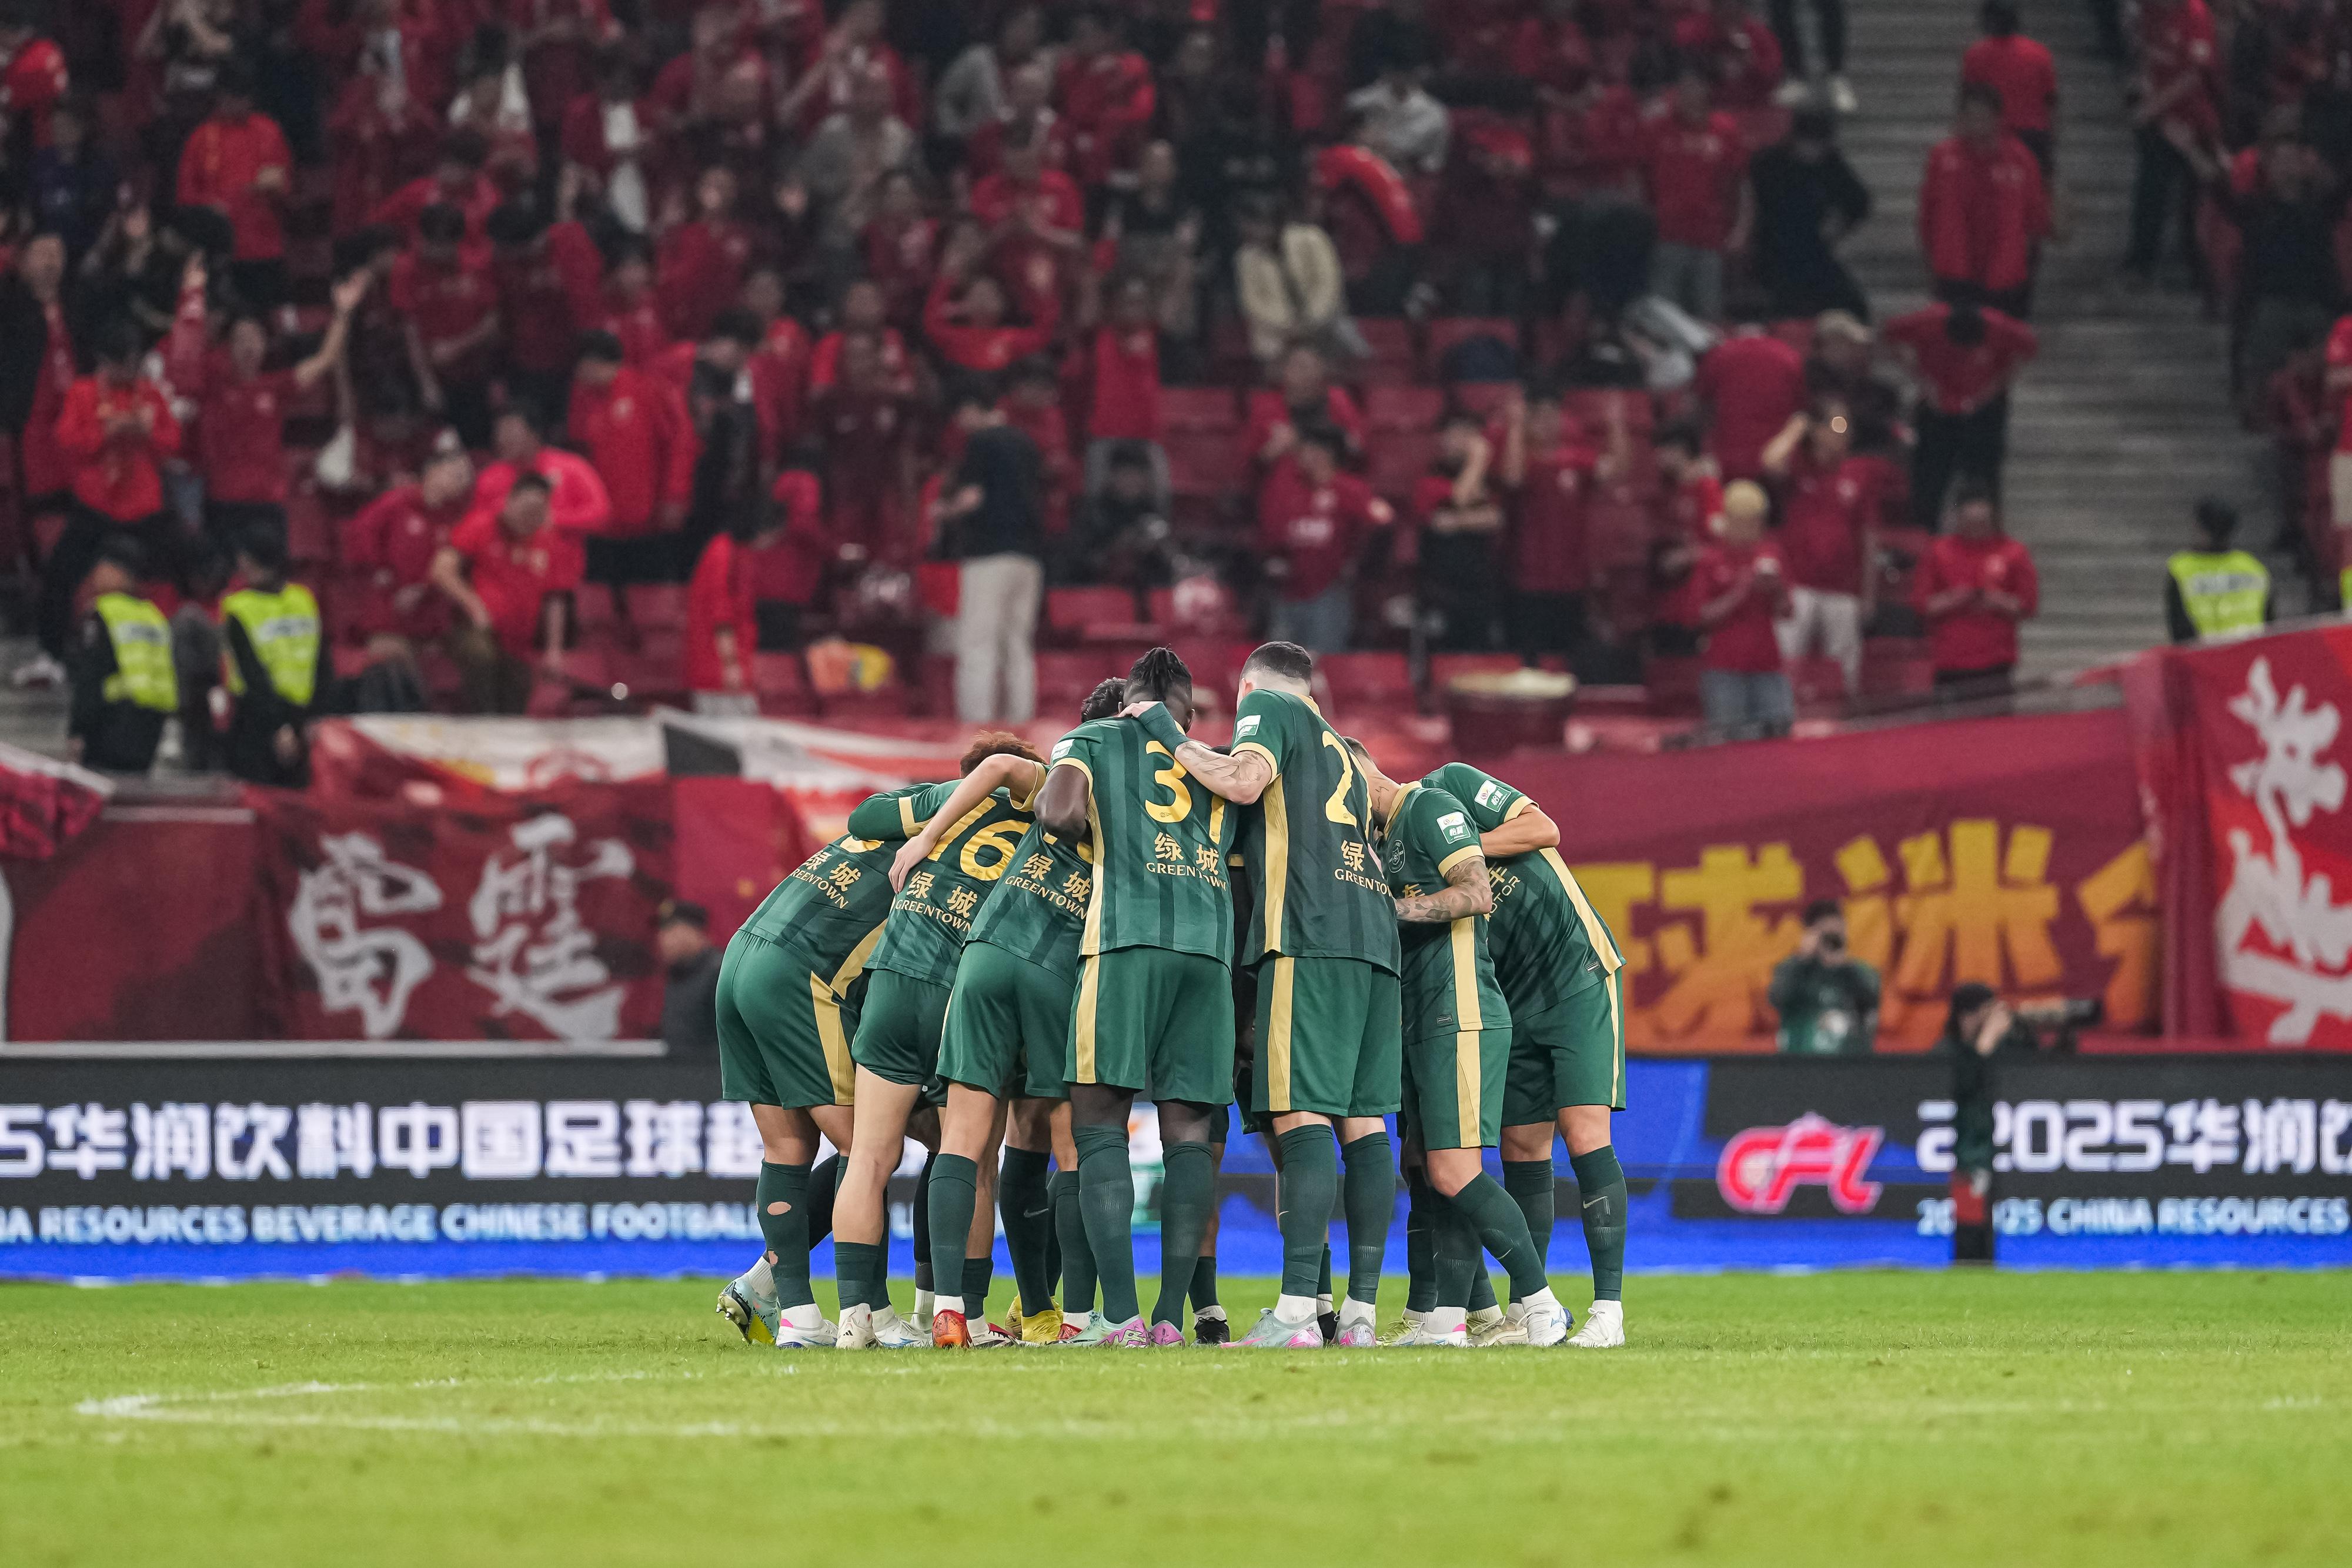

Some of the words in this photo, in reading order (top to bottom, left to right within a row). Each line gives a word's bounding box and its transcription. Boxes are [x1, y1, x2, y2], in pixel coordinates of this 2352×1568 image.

[927, 797, 1033, 881] 16
[906, 870, 978, 918] 绿城
[1005, 875, 1087, 920] GREENTOWN
[1020, 852, 1091, 902] 绿城
[895, 898, 971, 932] GREENTOWN
[39, 1205, 248, 1244] RESOURCES
[250, 1203, 437, 1242] BEVERAGE
[441, 1202, 587, 1242] CHINESE
[2047, 1197, 2154, 1236] CHINA
[2157, 1196, 2350, 1235] RESOURCES
